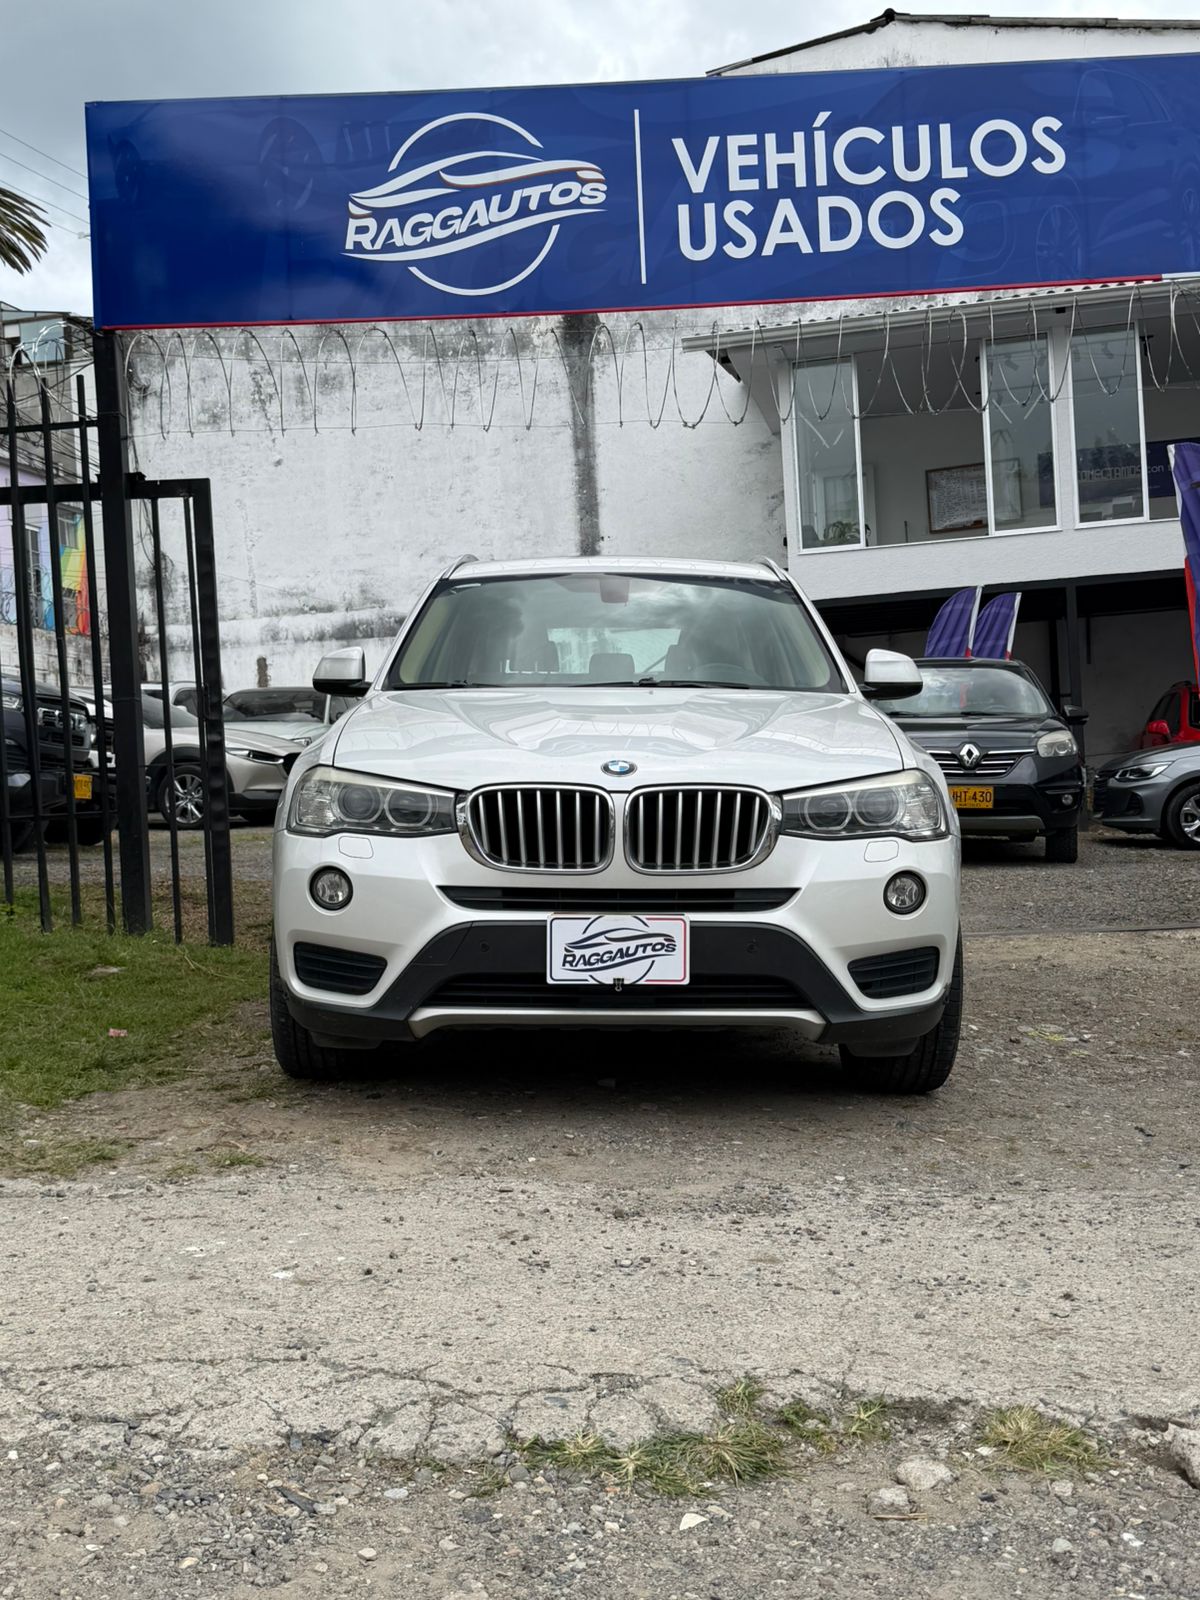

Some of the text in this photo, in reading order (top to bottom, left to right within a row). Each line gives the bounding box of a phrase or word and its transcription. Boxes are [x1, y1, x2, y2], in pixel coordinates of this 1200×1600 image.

[671, 111, 1066, 193] VEHÍCULOS
[345, 181, 608, 250] RAGGAUTOS
[677, 187, 964, 261] USADOS
[562, 942, 677, 967] RAGGAUTOS
